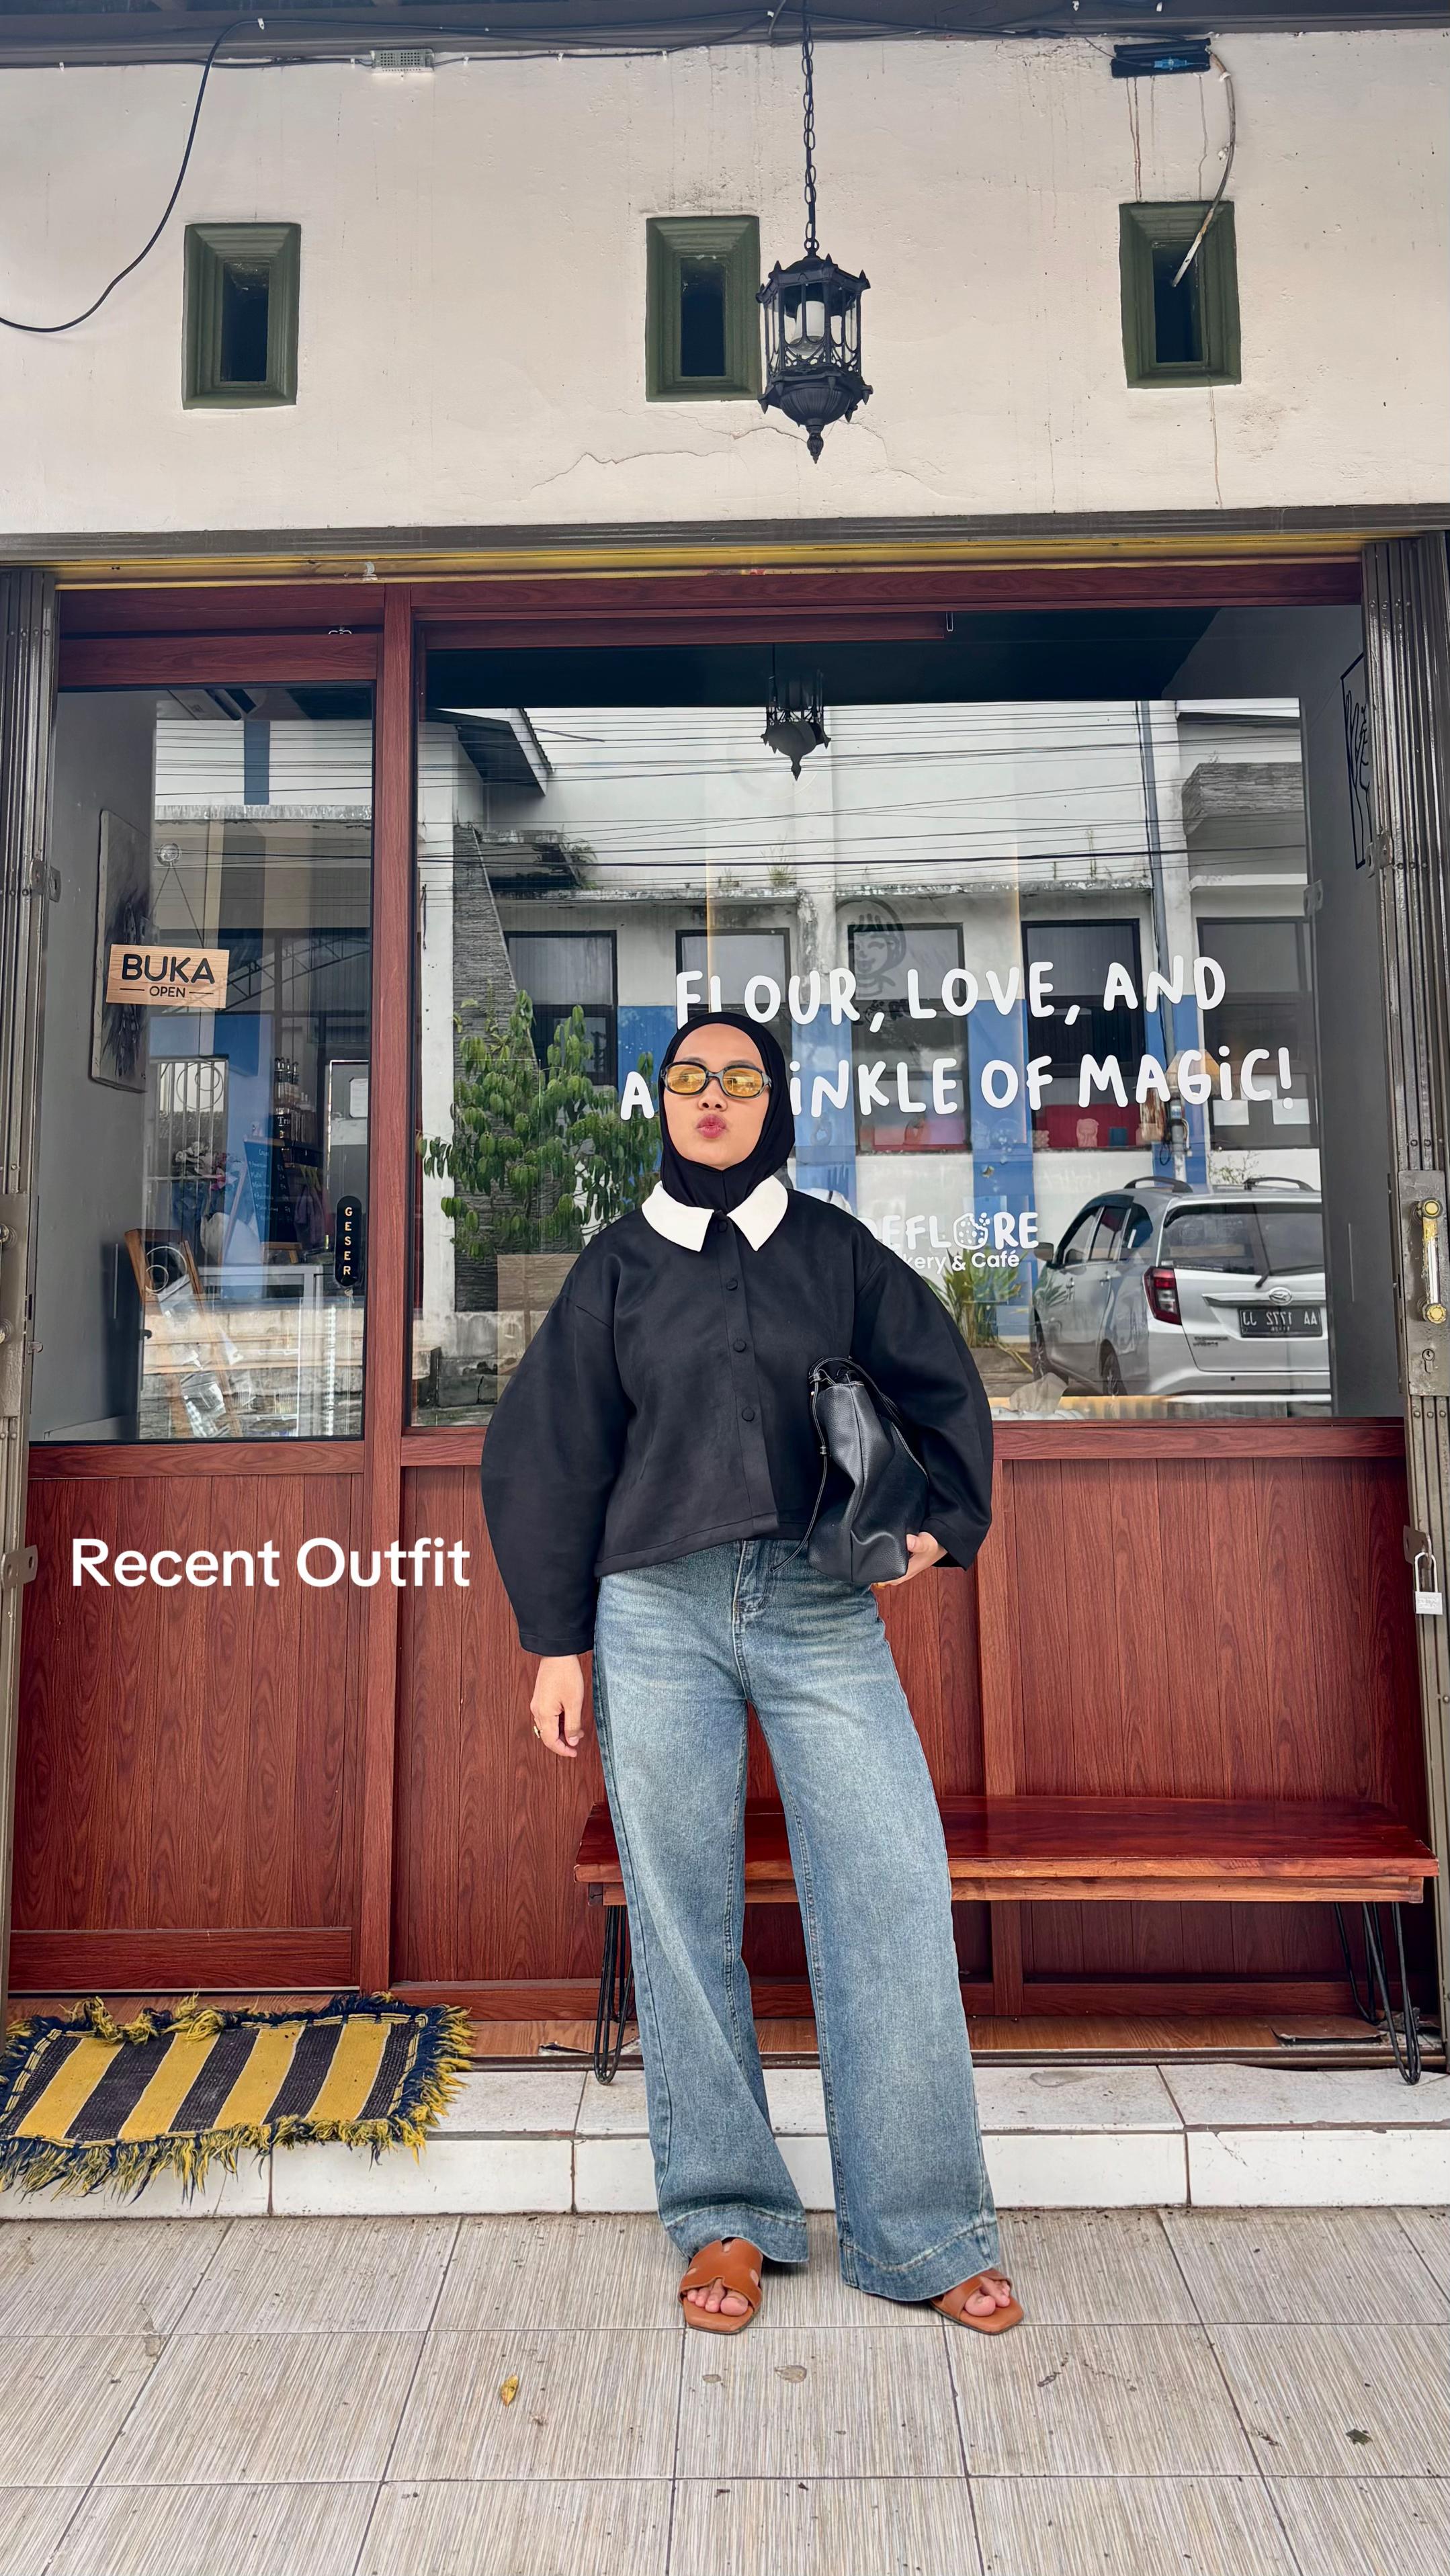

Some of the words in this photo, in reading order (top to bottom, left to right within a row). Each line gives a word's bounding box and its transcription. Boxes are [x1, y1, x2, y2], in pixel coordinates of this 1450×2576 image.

[122, 953, 215, 984] BUKA
[149, 986, 186, 998] OPEN
[906, 961, 1080, 1026] LOVE,
[1103, 954, 1226, 1013] AND
[620, 1070, 655, 1121] A
[980, 1055, 1054, 1111] OF
[343, 1206, 353, 1276] GESER
[903, 1252, 947, 1275] kery
[951, 1255, 966, 1272] &
[971, 1250, 1020, 1269] Café
